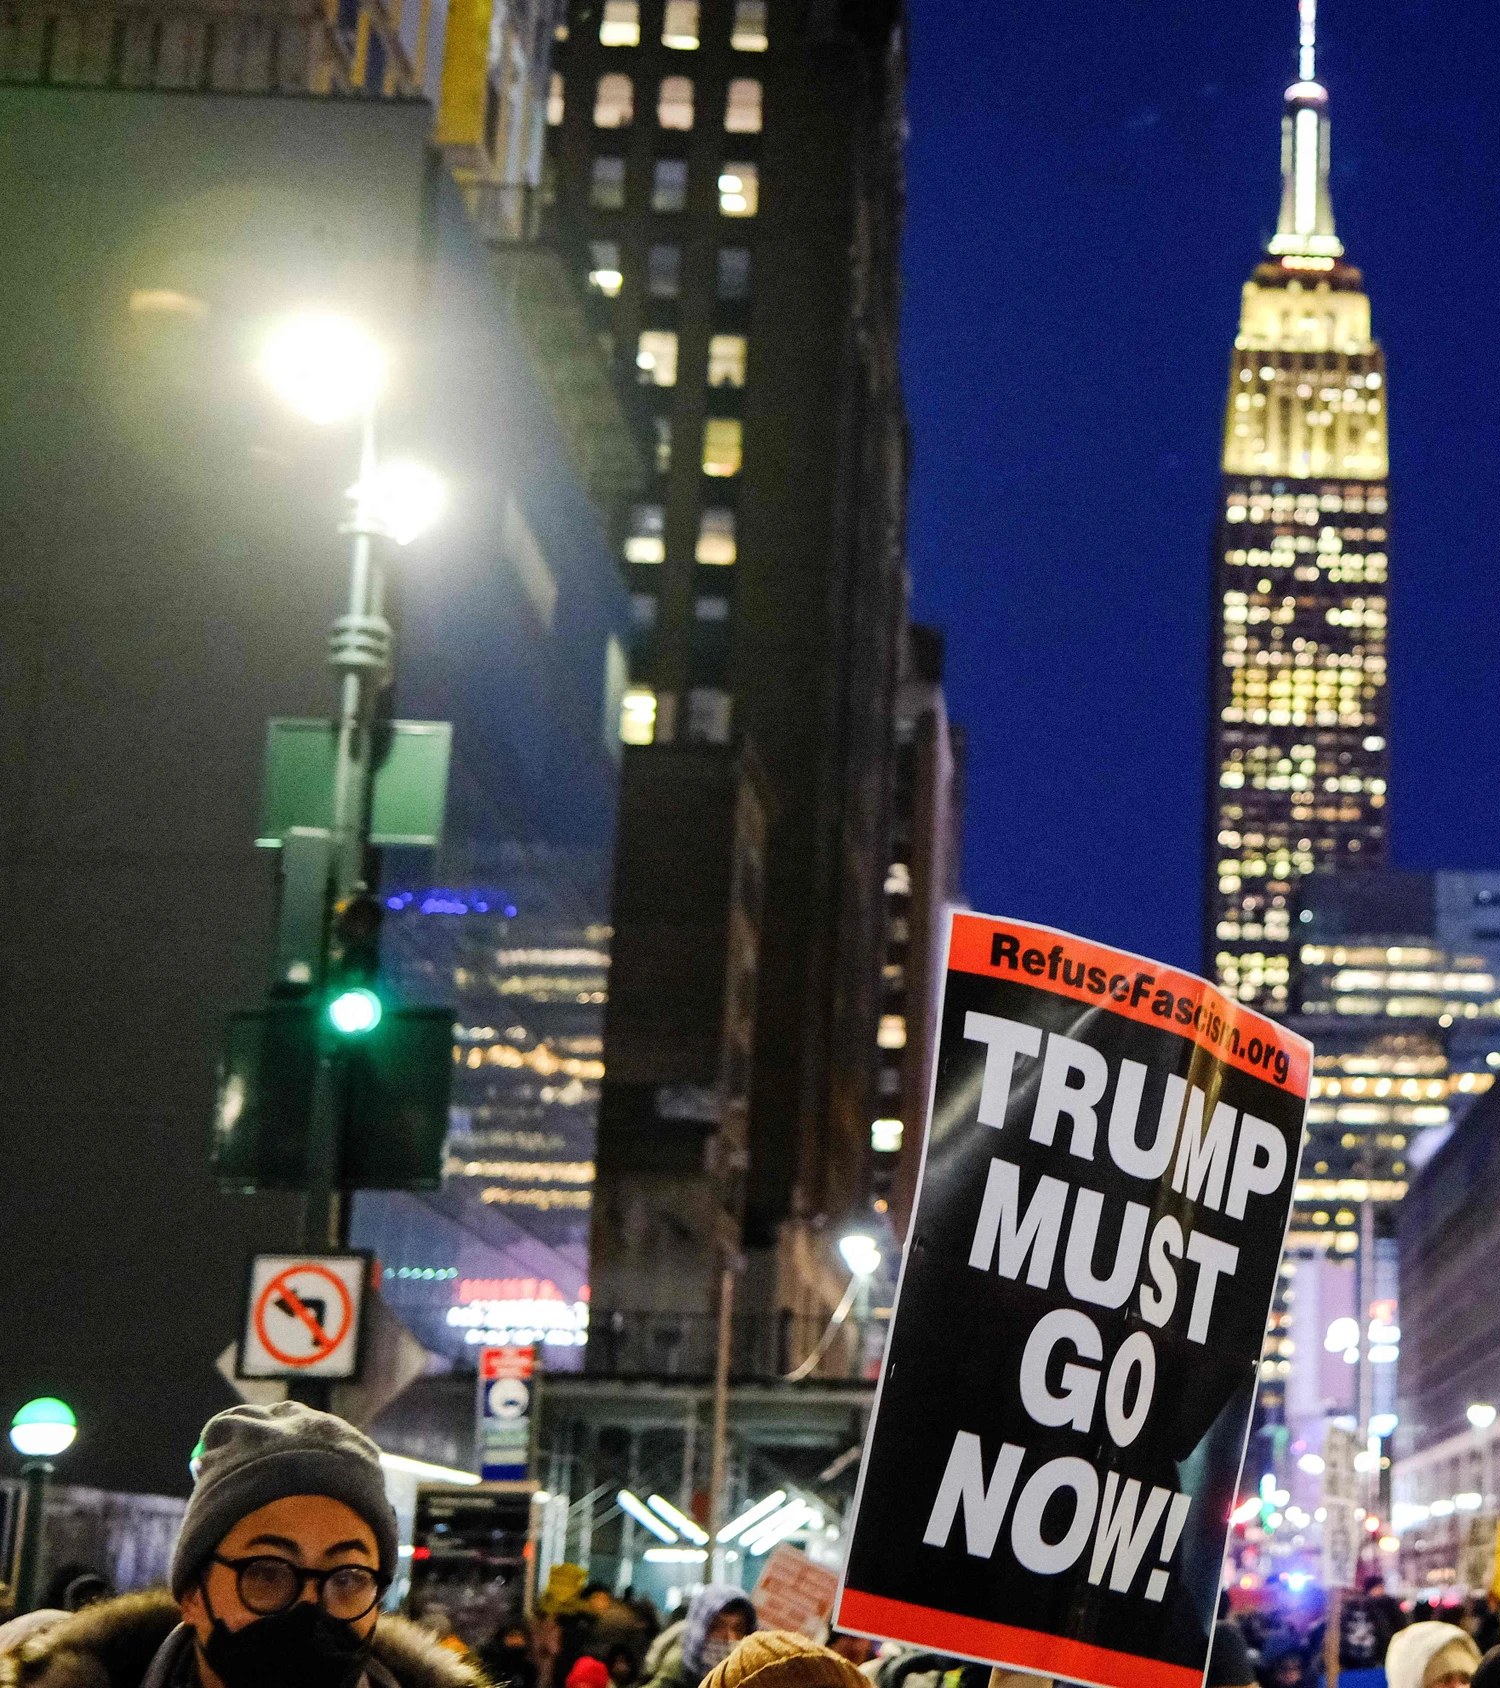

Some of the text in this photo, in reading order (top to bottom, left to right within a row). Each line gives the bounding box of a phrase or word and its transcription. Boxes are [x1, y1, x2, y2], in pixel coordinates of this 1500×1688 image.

[990, 932, 1291, 1084] RefuseFascism.org
[963, 1010, 1288, 1221] TRUMP
[967, 1157, 1240, 1345] MUST
[1019, 1308, 1156, 1448] GO
[922, 1429, 1192, 1603] NOW!
